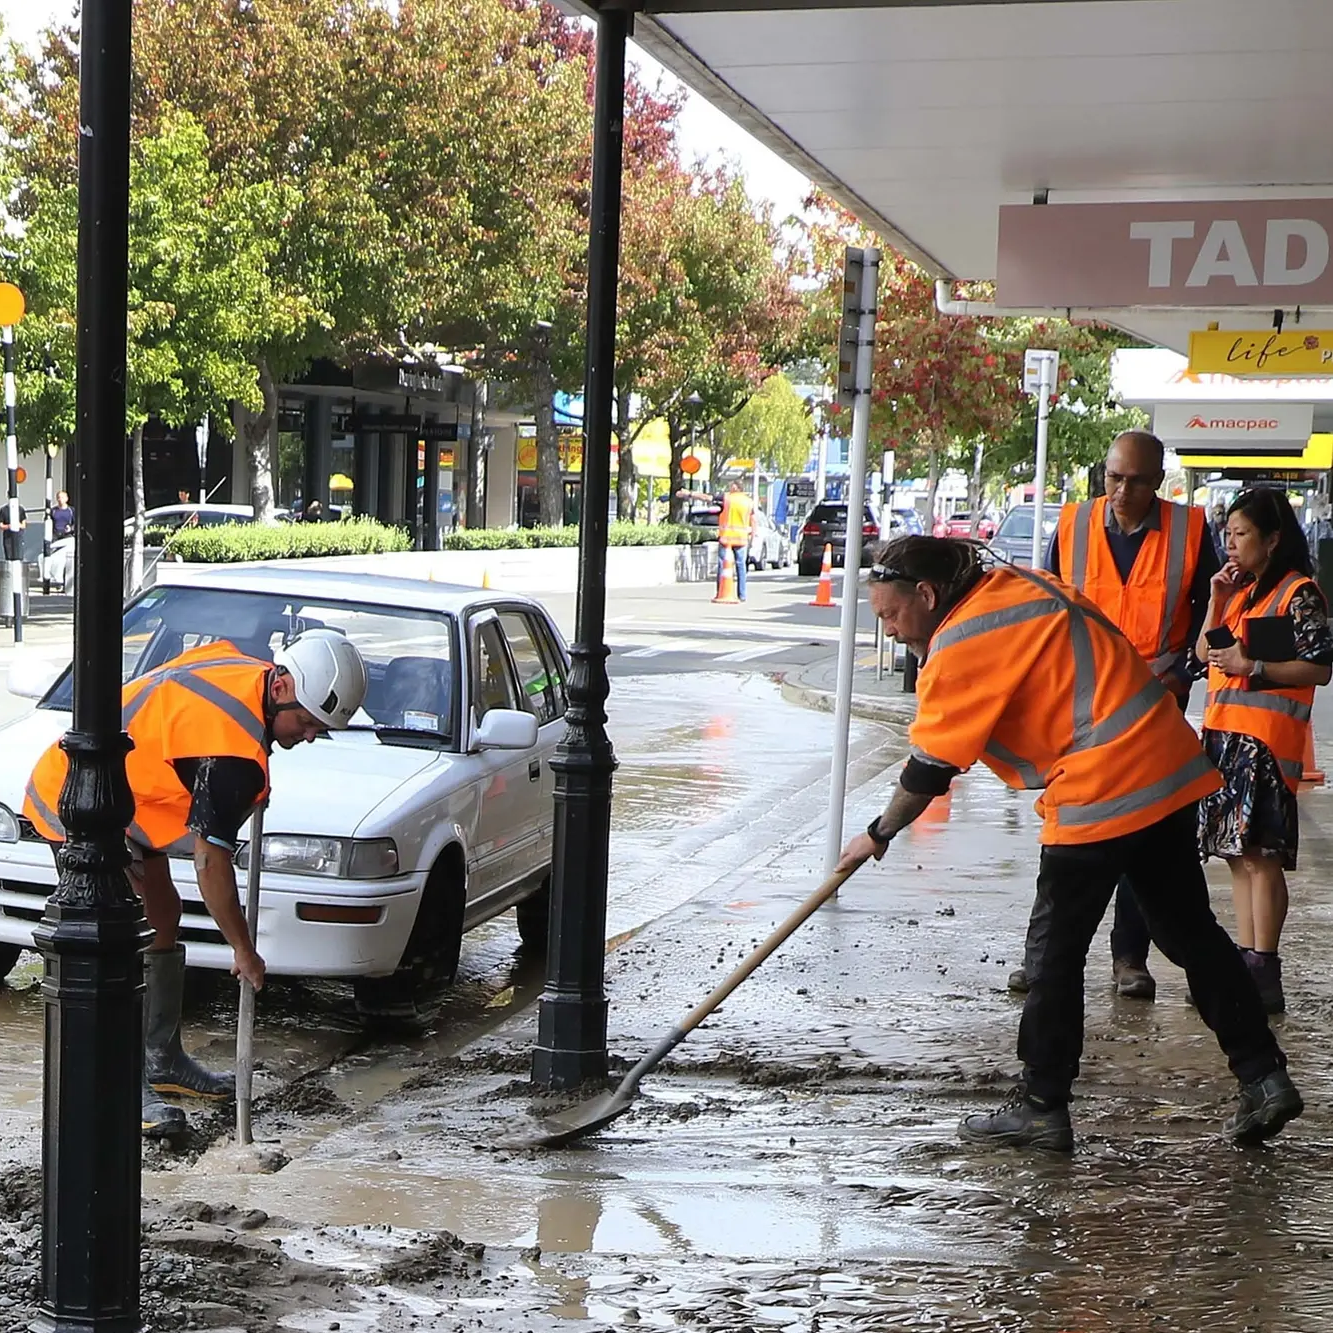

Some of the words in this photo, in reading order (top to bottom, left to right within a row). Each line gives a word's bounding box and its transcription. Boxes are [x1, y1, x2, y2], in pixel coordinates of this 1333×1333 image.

[1129, 219, 1329, 289] TAD
[1226, 334, 1304, 369] life
[1209, 418, 1279, 431] macpac
